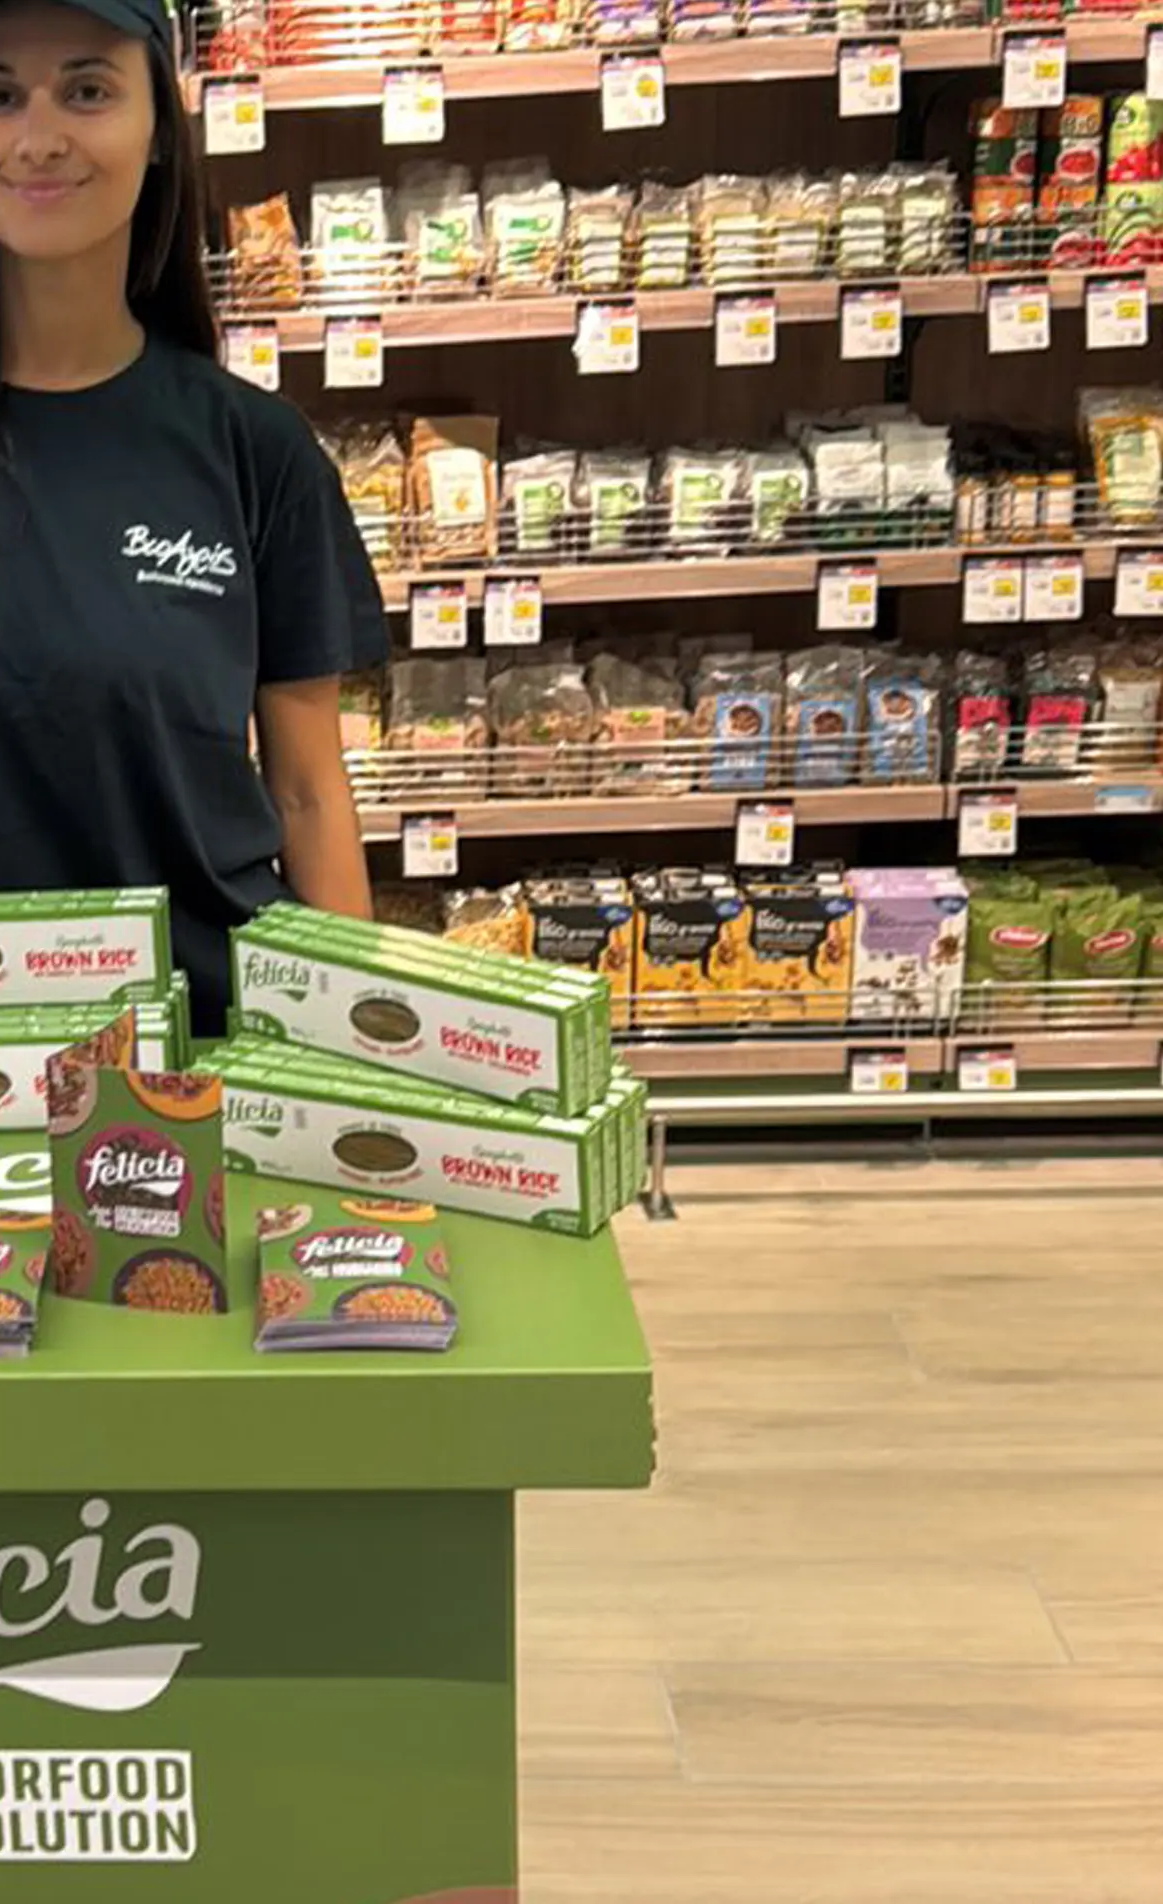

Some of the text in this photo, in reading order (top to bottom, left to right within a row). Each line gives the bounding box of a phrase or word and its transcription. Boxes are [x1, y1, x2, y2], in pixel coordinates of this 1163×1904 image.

[24, 947, 139, 971] BROWN RICE
[243, 951, 311, 992] felicia
[439, 1025, 501, 1057] BROWN
[504, 1043, 544, 1070] RICE
[84, 1144, 185, 1193] felicia
[440, 1154, 512, 1186] BROWN
[517, 1168, 562, 1194] RICE
